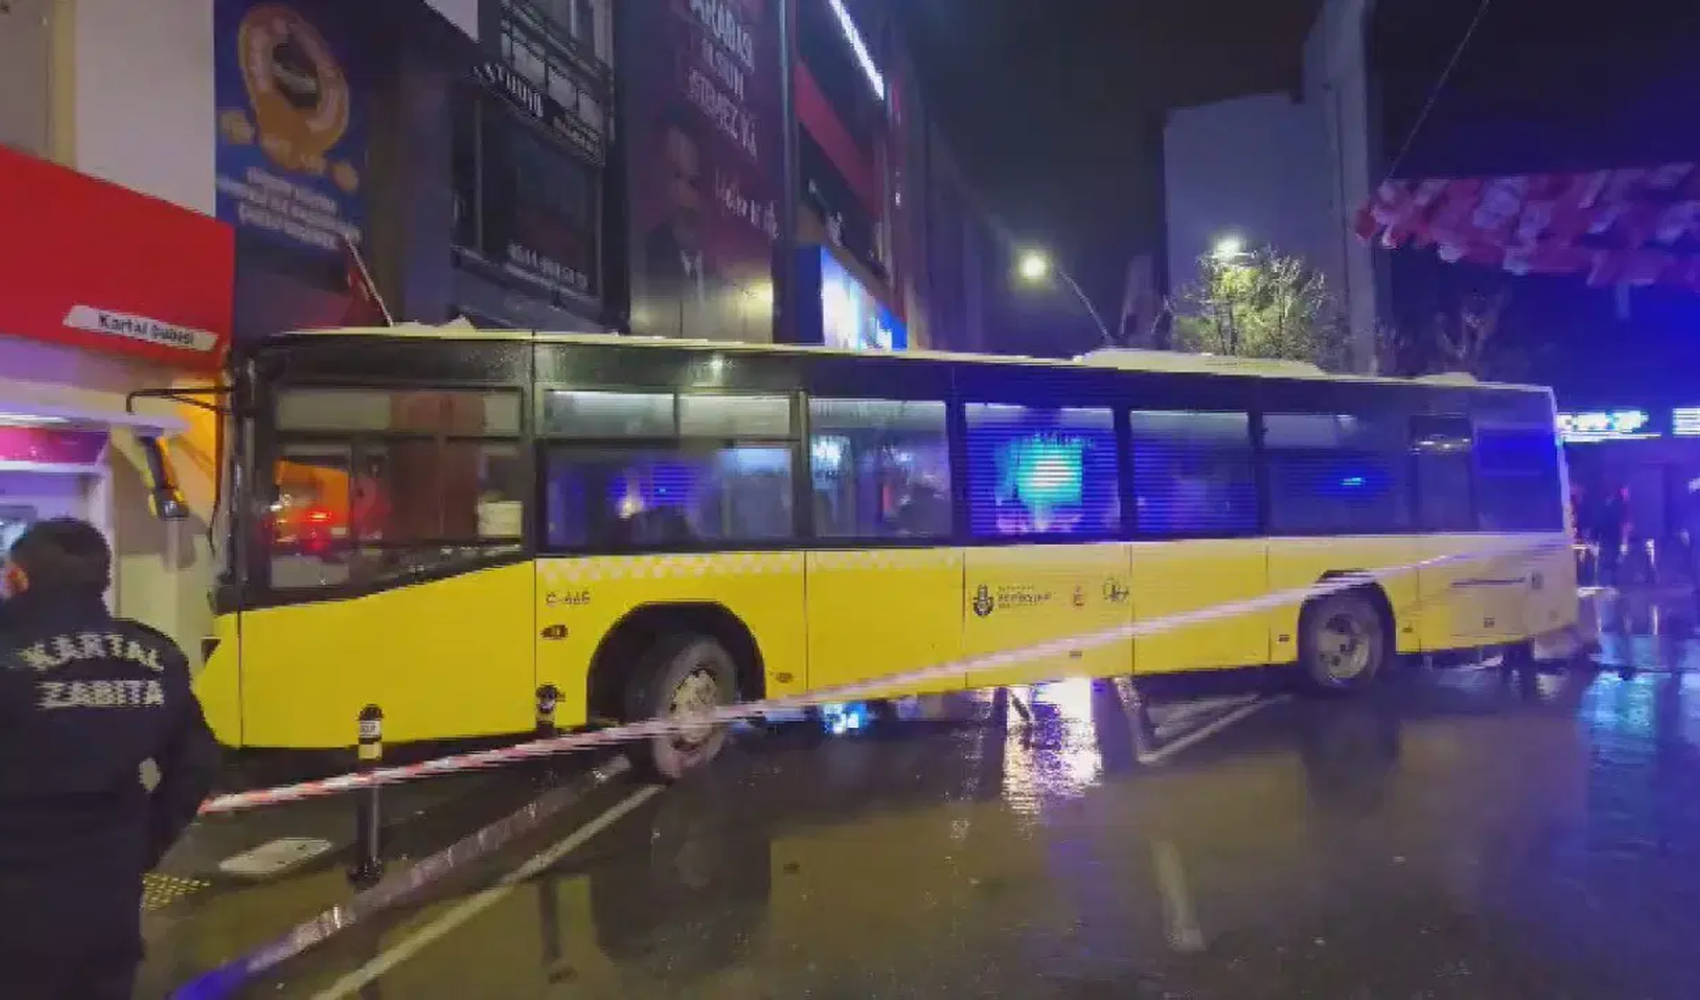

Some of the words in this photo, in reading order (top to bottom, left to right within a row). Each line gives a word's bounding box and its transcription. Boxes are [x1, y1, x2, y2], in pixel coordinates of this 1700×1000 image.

[98, 312, 148, 335] Kartal
[14, 632, 165, 672] KARTAL
[35, 680, 165, 709] ZABITA
